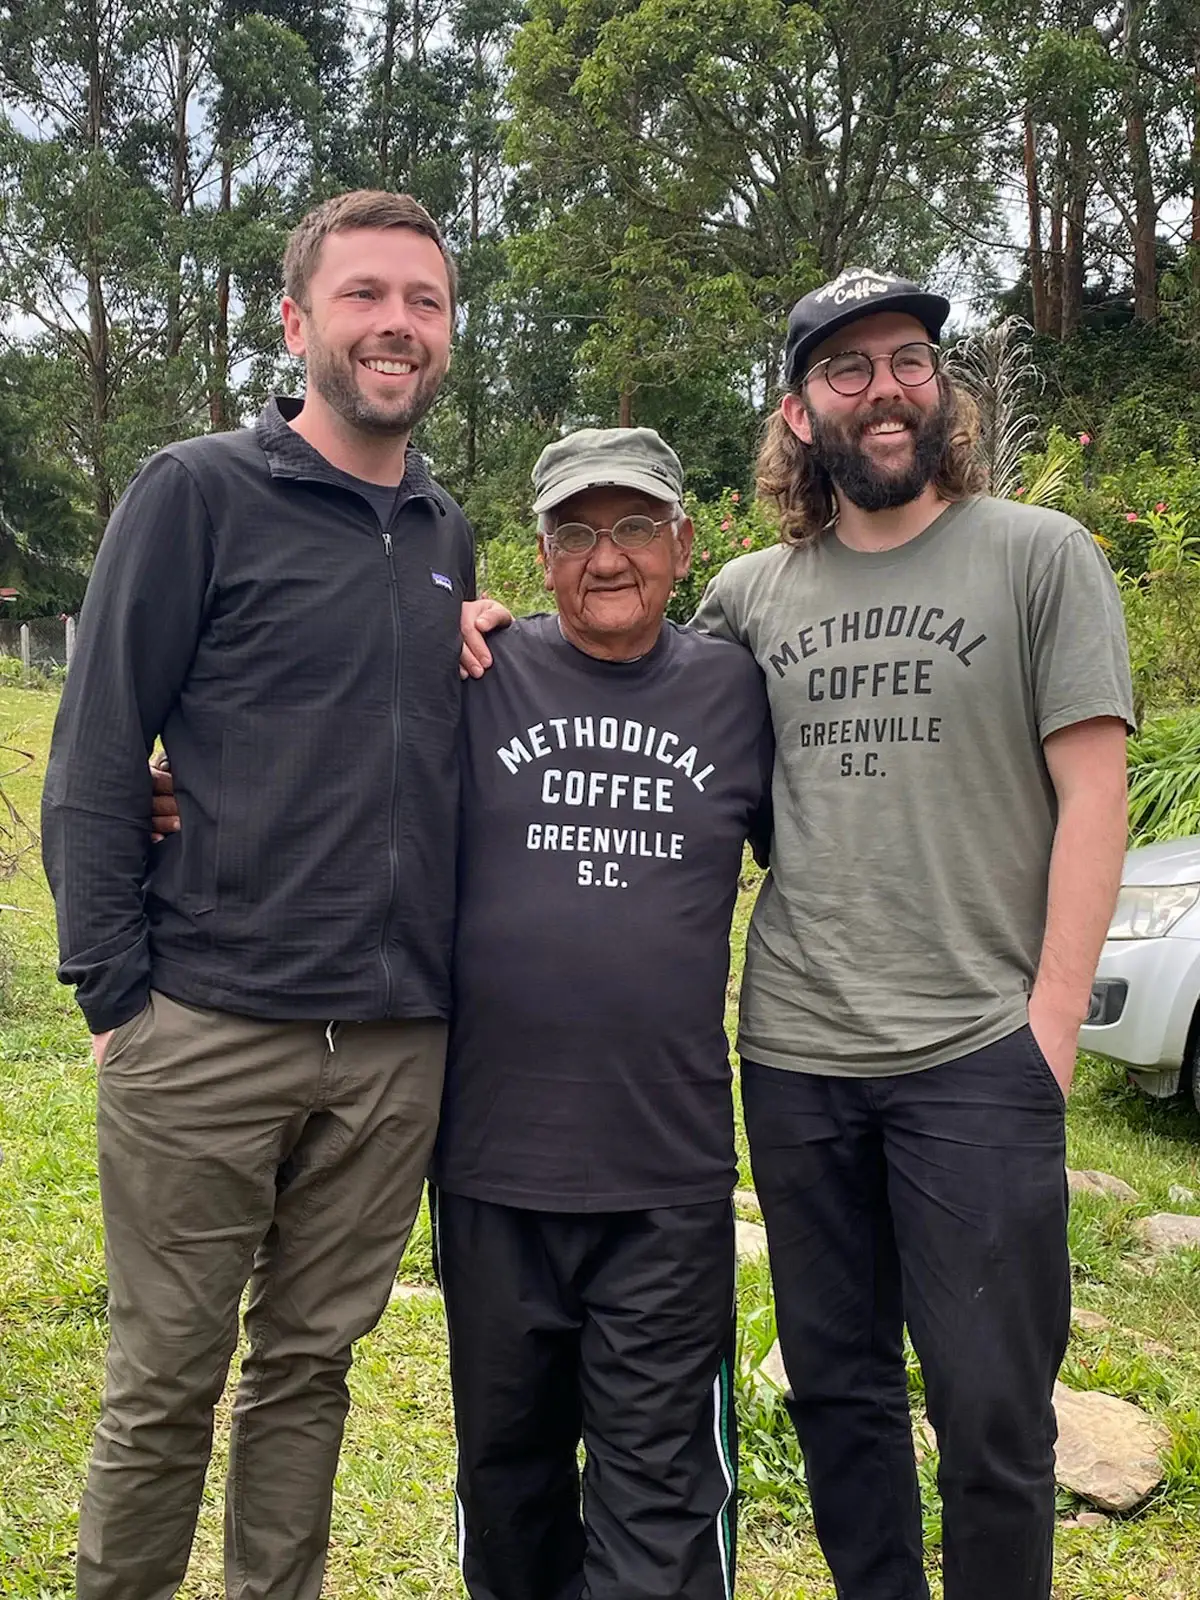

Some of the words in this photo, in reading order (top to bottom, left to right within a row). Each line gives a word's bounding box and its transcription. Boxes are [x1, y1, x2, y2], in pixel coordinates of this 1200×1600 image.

[834, 279, 888, 304] Coffee
[768, 605, 987, 678] METHODICAL
[808, 660, 933, 702] COFFEE
[800, 717, 942, 747] GREENVILLE
[496, 716, 715, 793] METHODICAL
[840, 752, 886, 777] S.C.
[541, 769, 674, 813] COFFEE
[526, 823, 684, 860] GREENVILLE
[577, 860, 628, 888] S.C.
